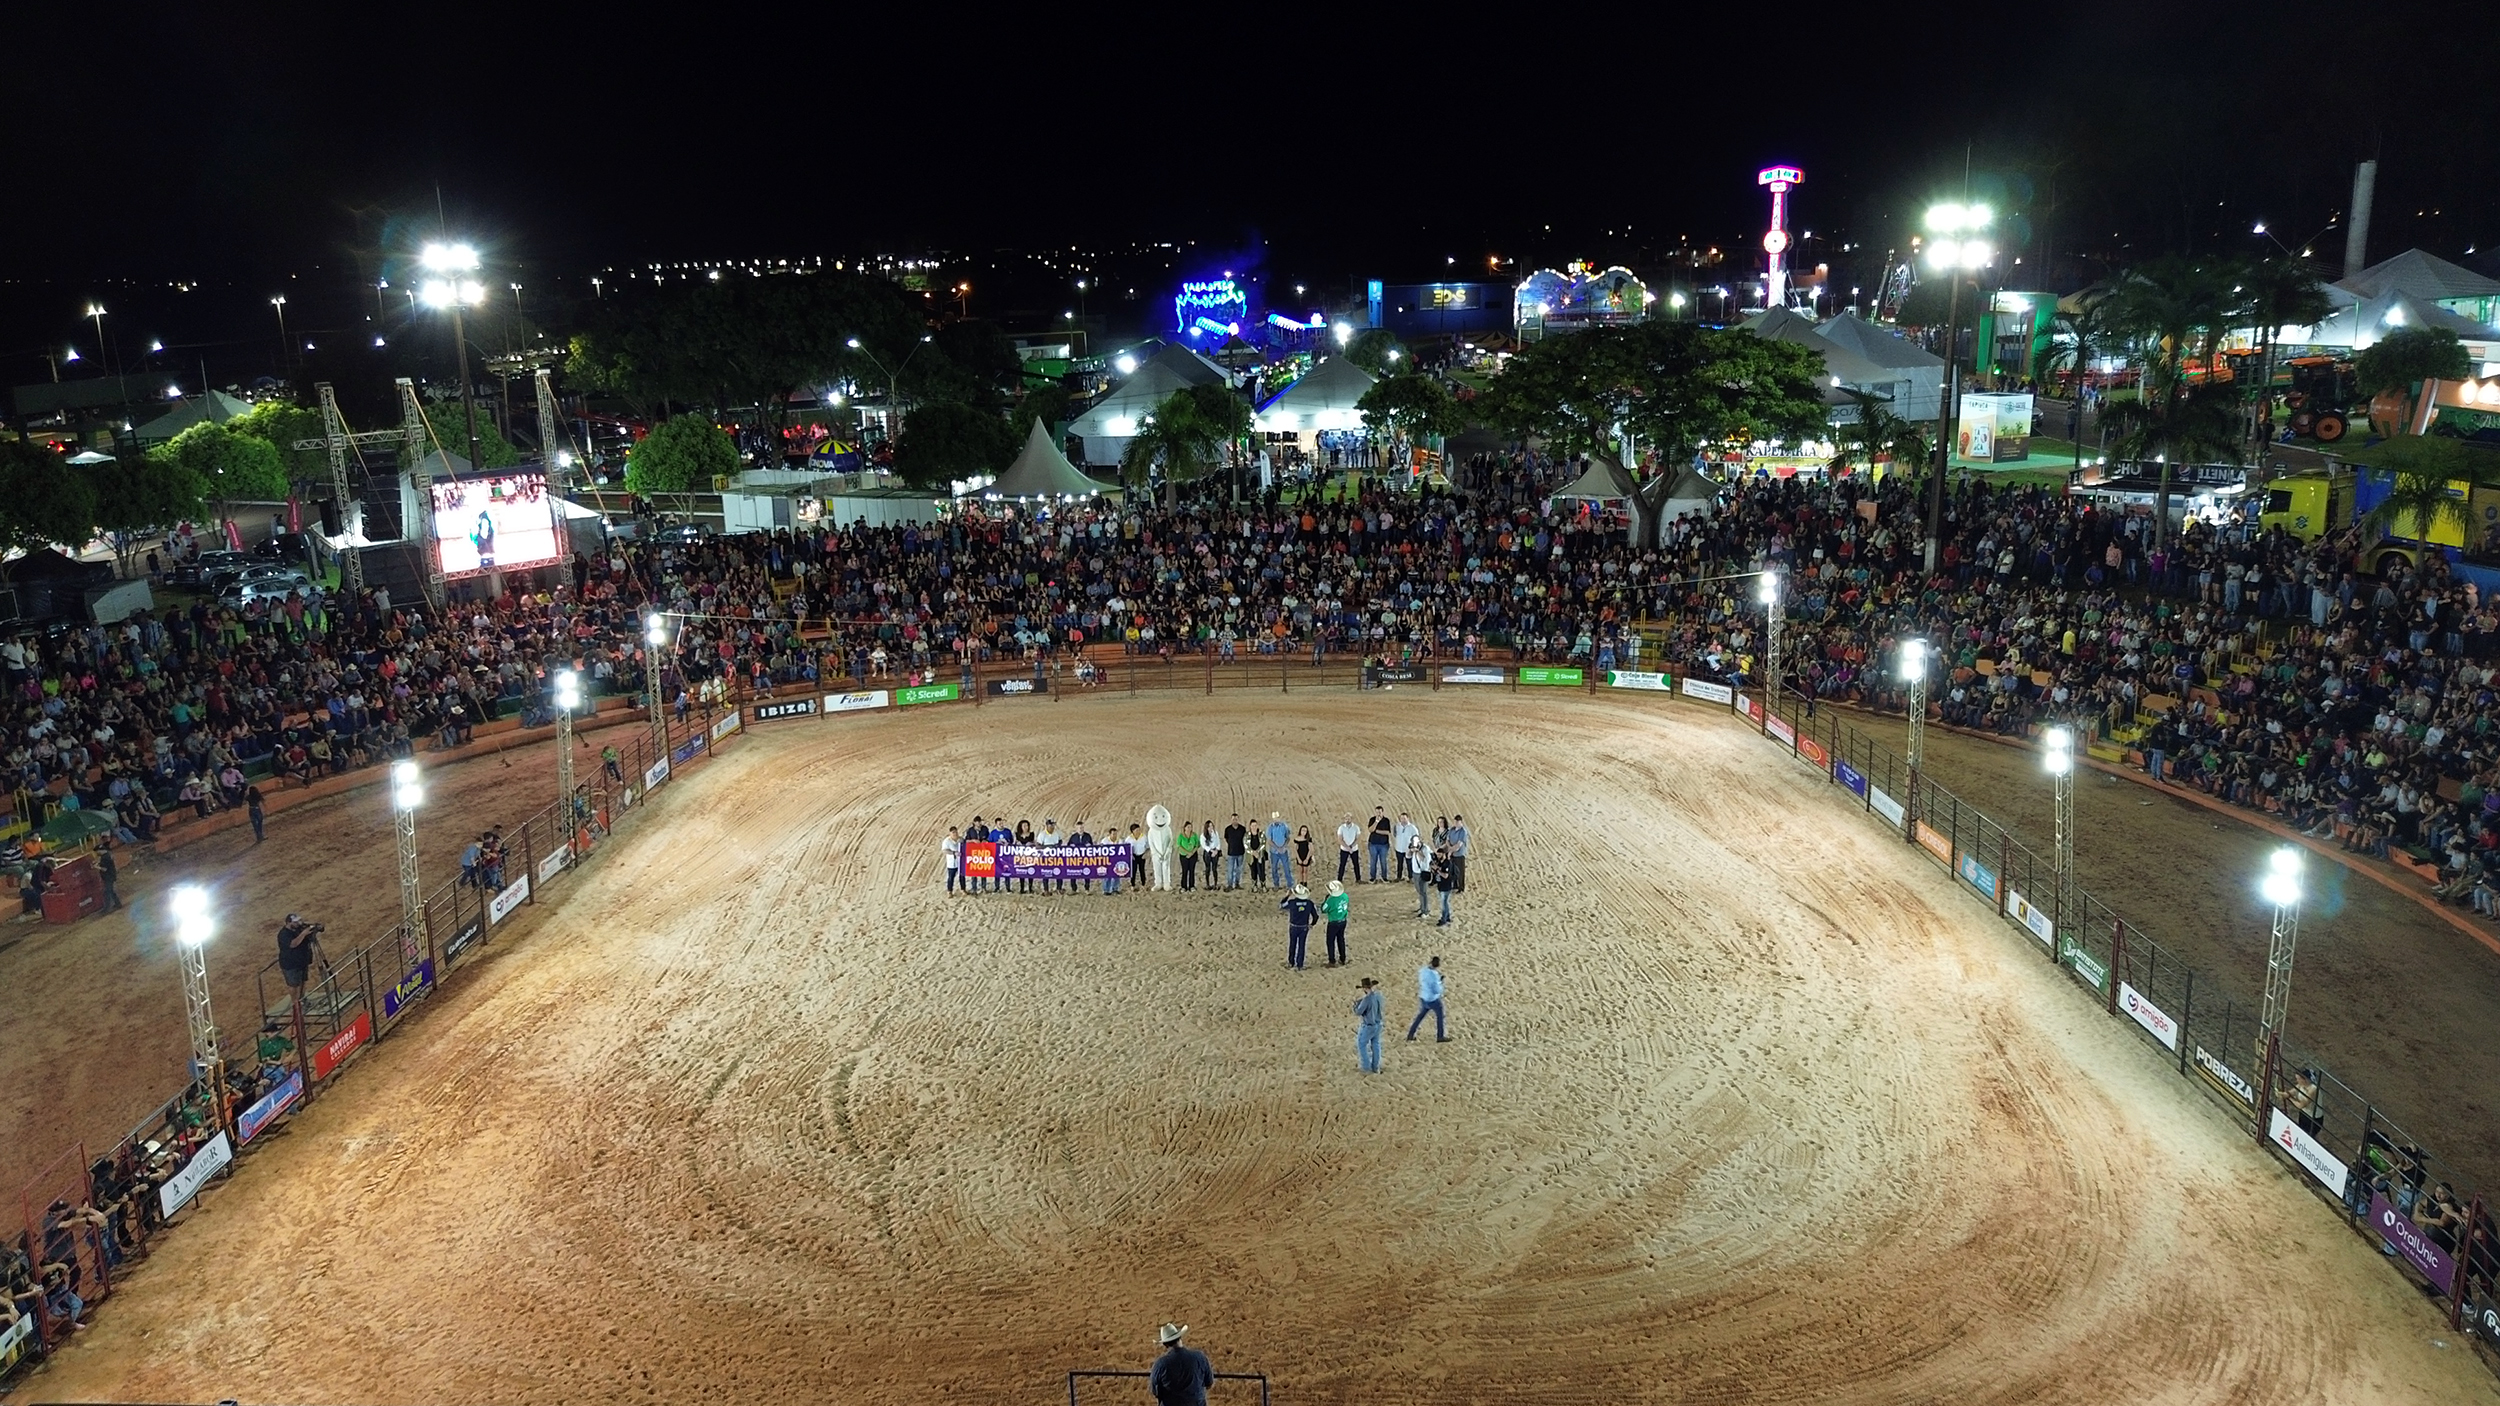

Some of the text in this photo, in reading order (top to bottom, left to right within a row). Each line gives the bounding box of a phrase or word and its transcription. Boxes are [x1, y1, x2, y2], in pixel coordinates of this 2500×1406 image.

[917, 688, 949, 701] Sicredi
[971, 849, 991, 857] END
[1042, 846, 1116, 857] COMBATEMOS
[1118, 845, 1126, 856] A
[966, 856, 995, 865] POLIO
[969, 862, 992, 871] NOW
[1013, 856, 1112, 867] PARALISIA INFANTIL
[2140, 1004, 2169, 1033] amigão
[329, 1025, 356, 1055] NAVIRAÍ
[2196, 1045, 2255, 1104] POBREZA
[2293, 1136, 2336, 1181] Anhanguera
[2395, 1221, 2439, 1268] OralUnic
